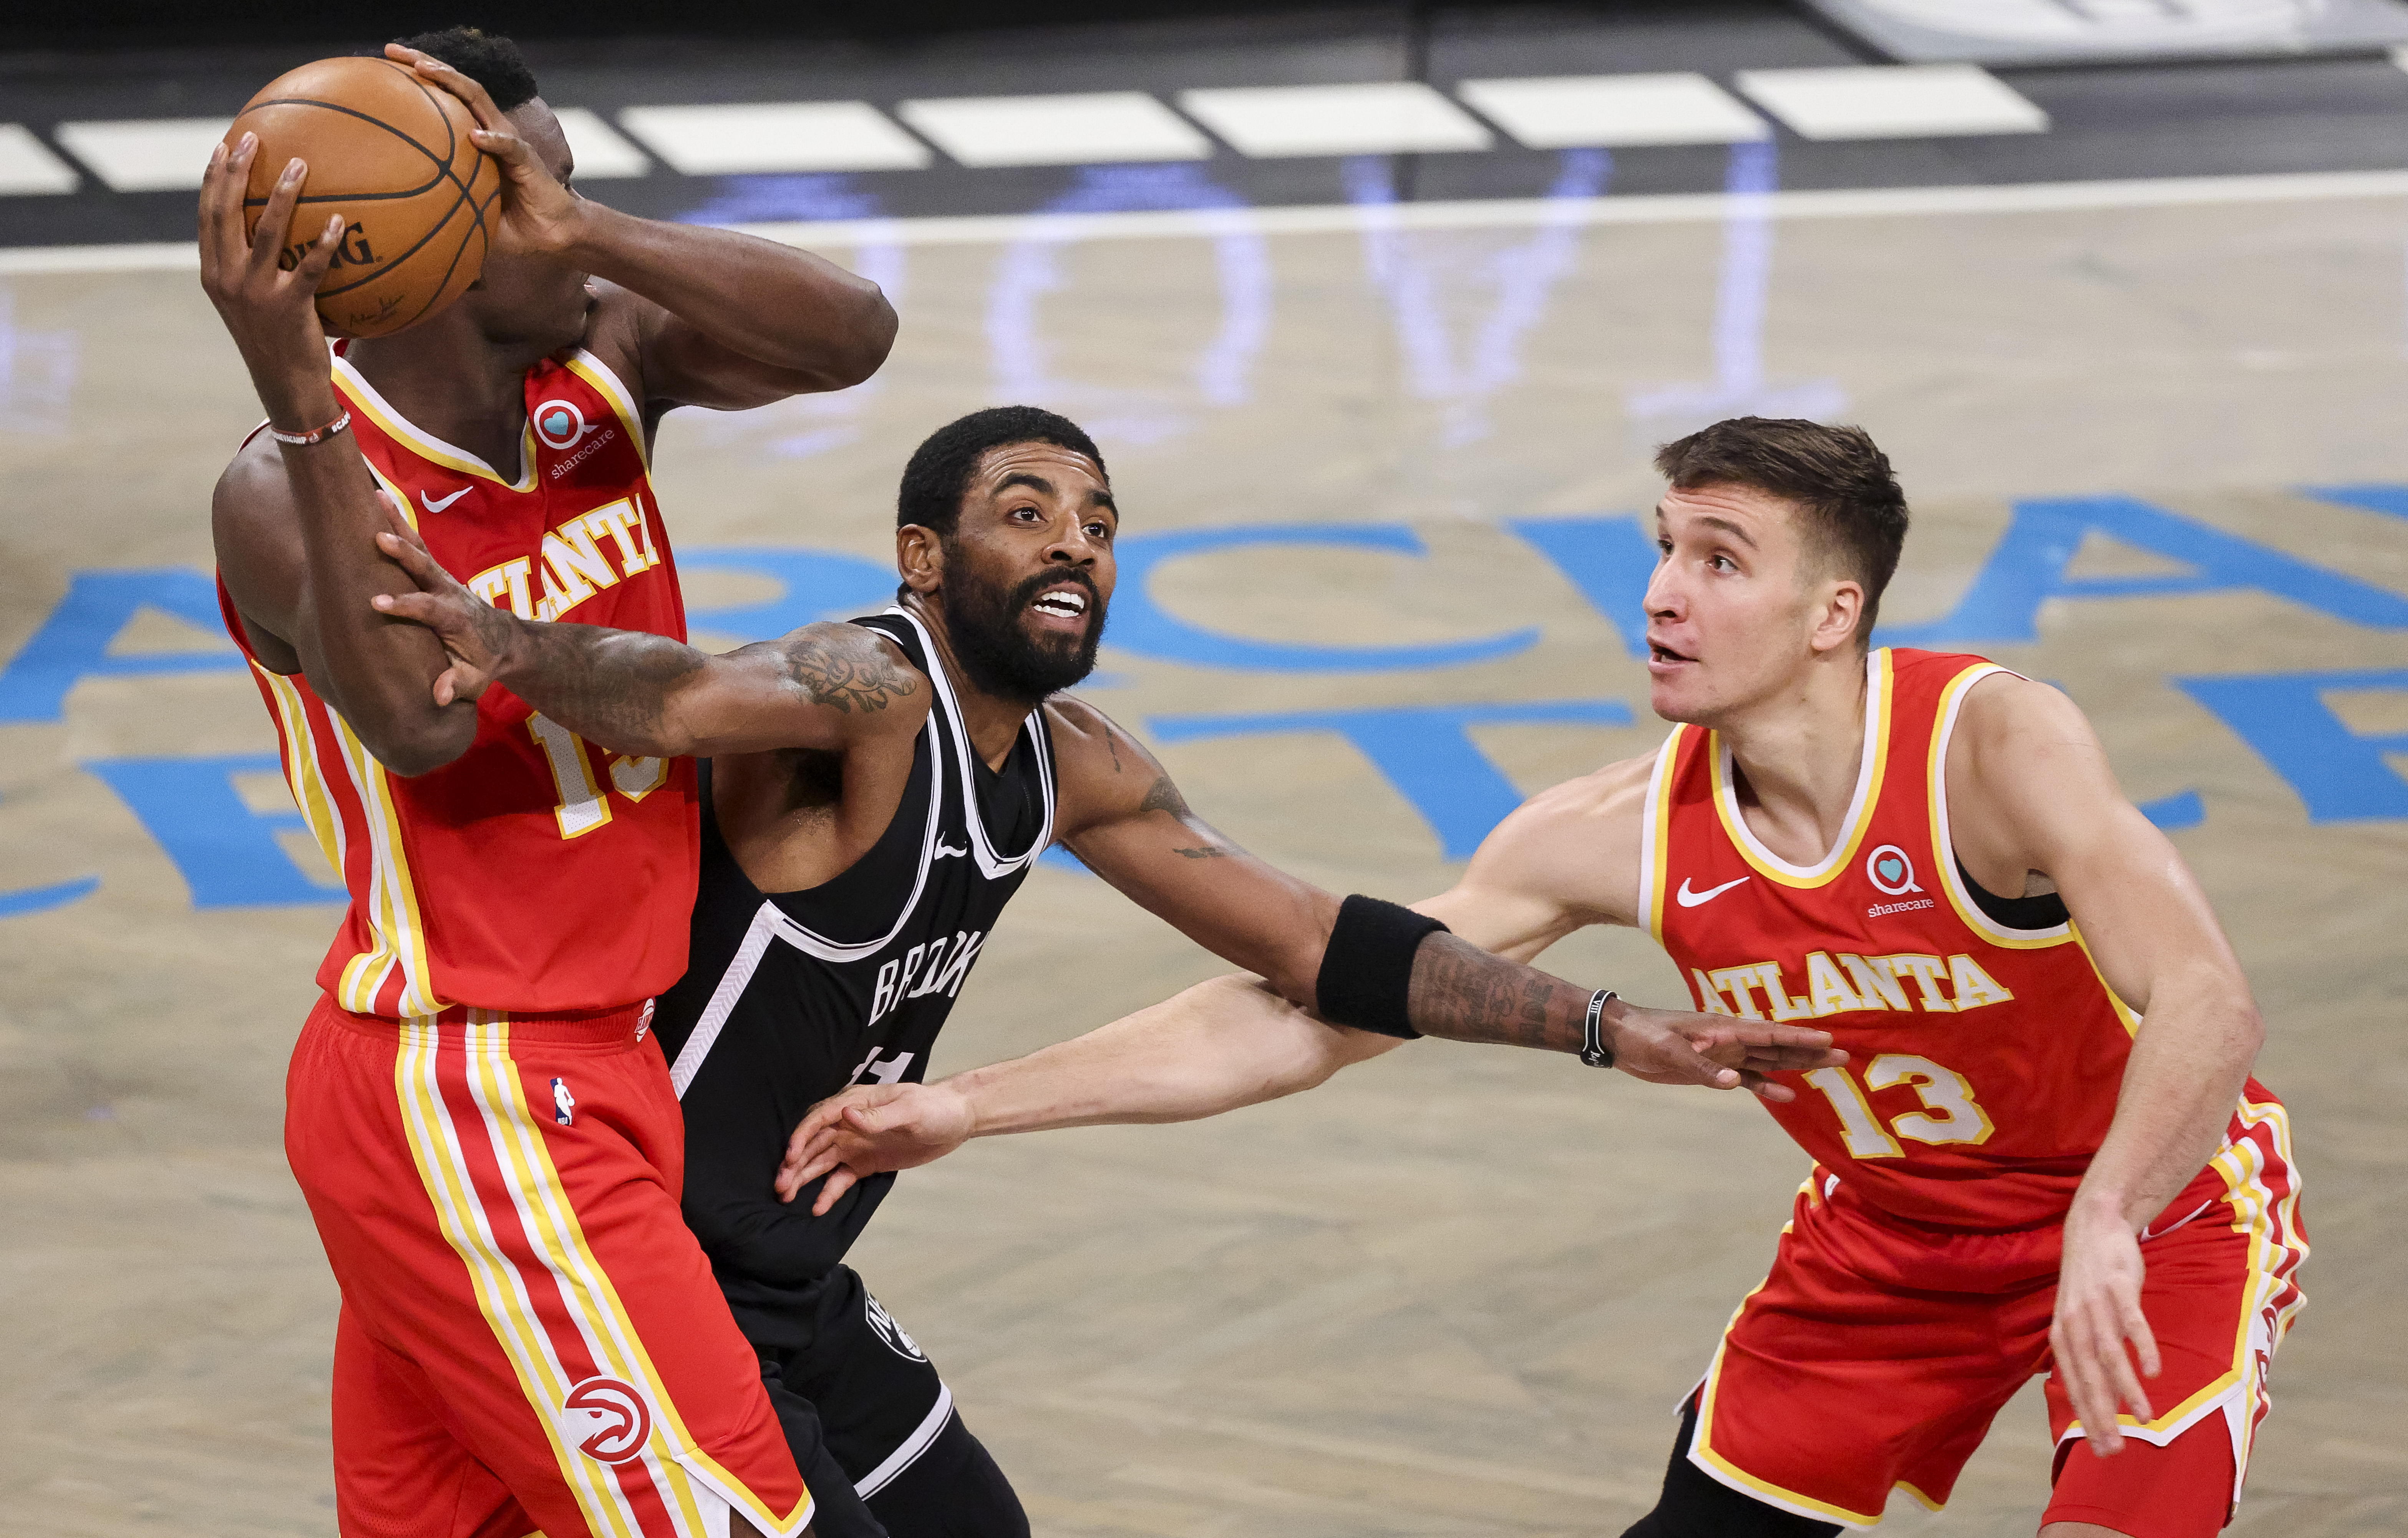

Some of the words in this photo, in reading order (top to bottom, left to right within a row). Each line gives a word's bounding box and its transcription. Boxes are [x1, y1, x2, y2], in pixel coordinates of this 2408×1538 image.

[551, 428, 615, 480] sharecare
[1868, 897, 1934, 918] sharecare
[1691, 950, 2015, 1022] ATLANTA
[557, 1117, 568, 1125] NBA
[1801, 1053, 1995, 1159] 13
